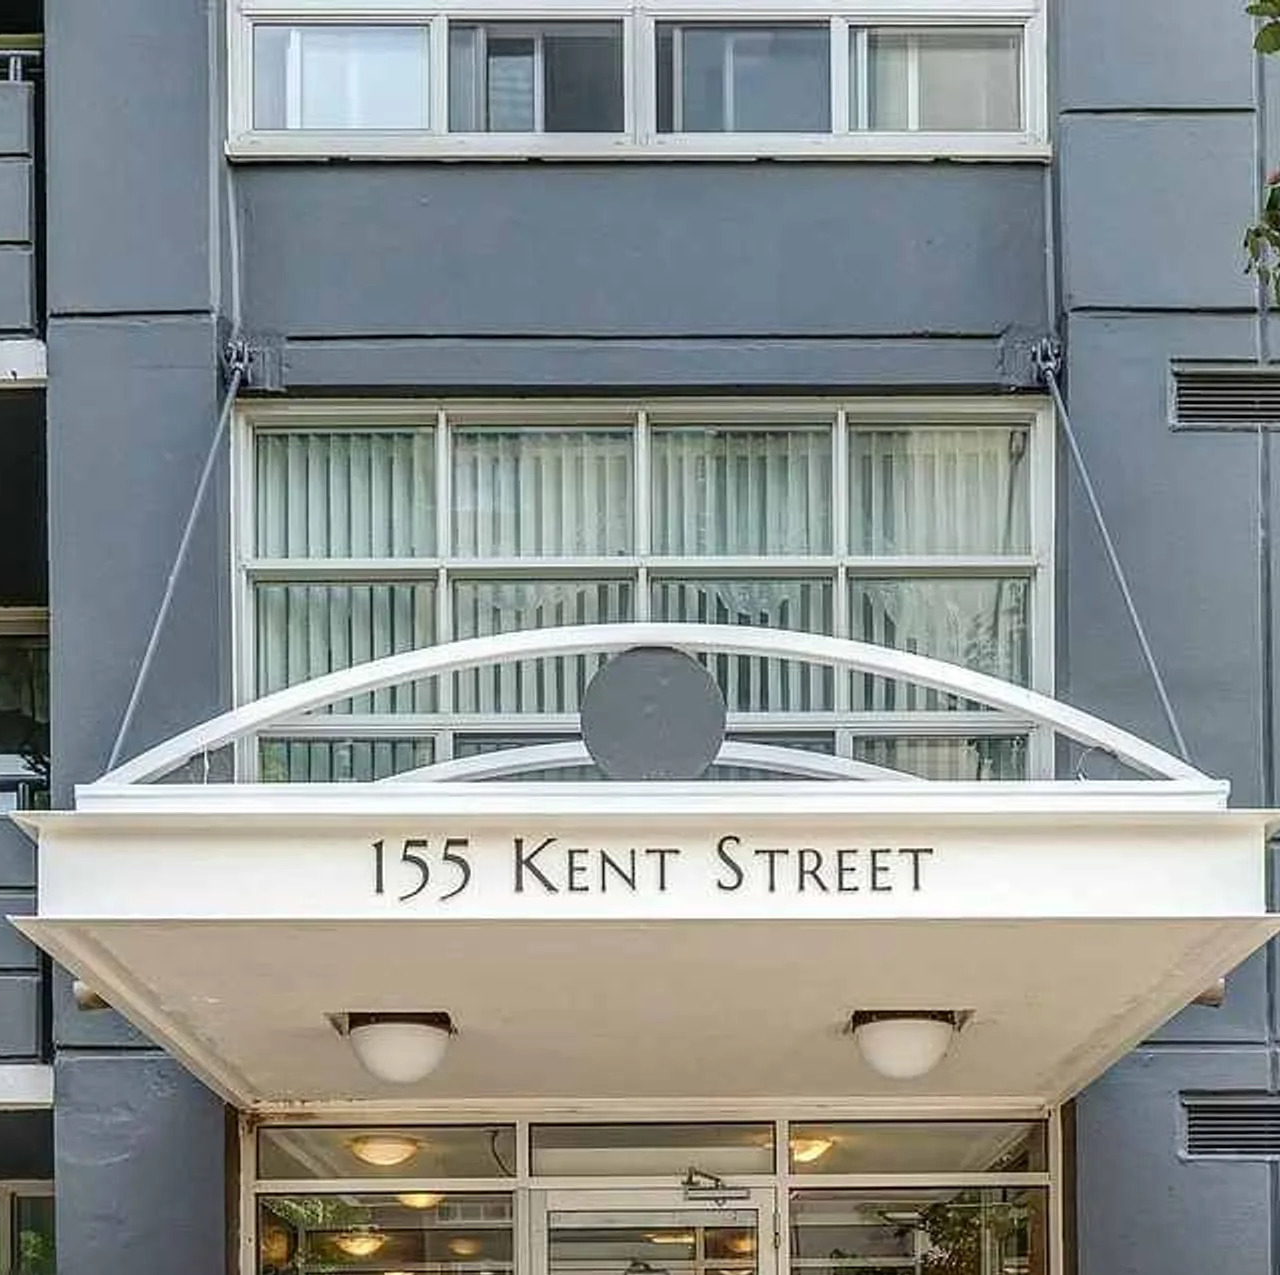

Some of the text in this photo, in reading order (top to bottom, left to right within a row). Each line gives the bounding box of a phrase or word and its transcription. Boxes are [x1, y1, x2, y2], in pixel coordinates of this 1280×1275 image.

[371, 835, 934, 901] 155 KENT STREET
